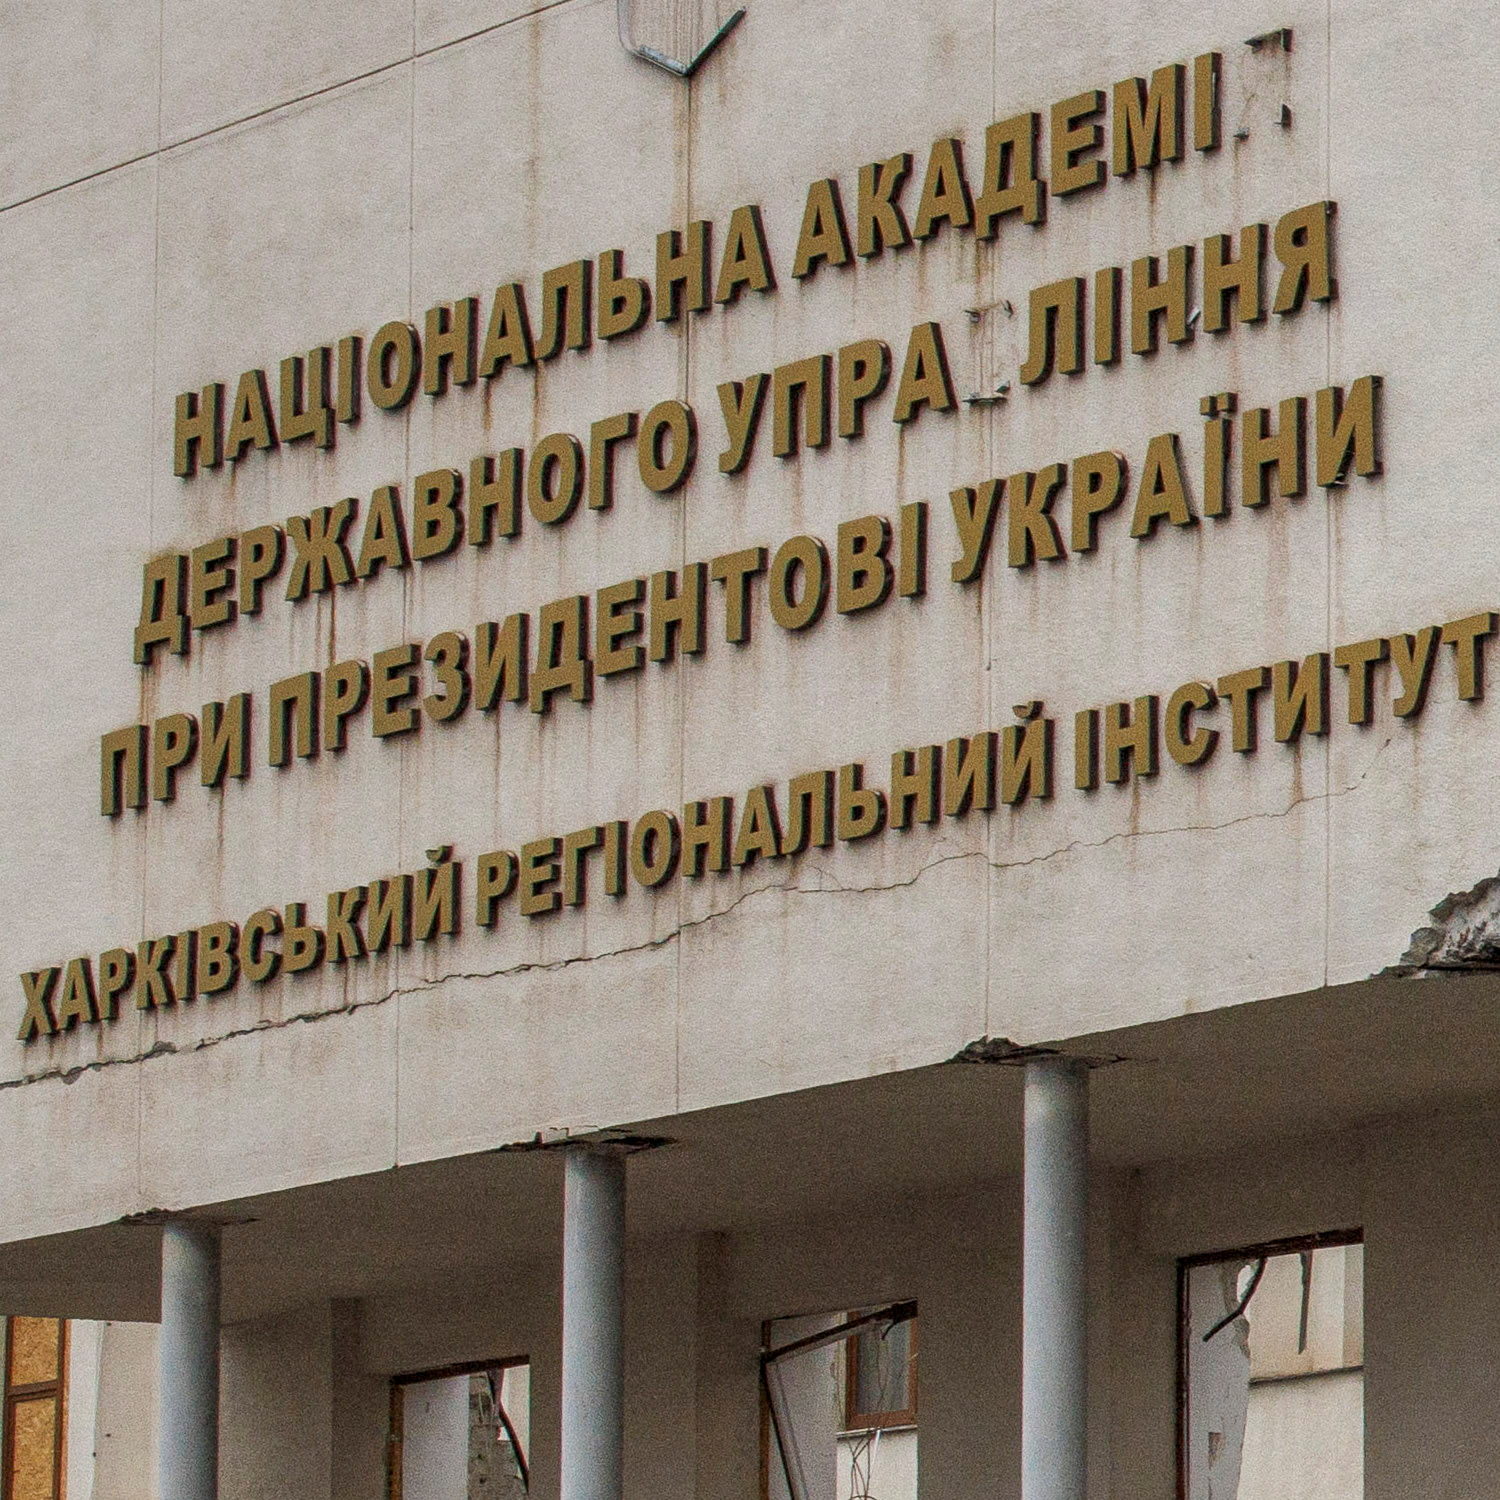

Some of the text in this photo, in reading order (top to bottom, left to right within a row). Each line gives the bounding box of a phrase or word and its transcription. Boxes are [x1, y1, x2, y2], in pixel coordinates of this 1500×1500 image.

[133, 200, 1338, 665] ДЕРЖАВНОГО УПРАЛІННЯ
[174, 28, 1294, 478] НАЦІОНАЛЬНА АКАДЕМІ
[100, 374, 1384, 817] ПРИ ПРЕЗИДЕНТОВІ УКРАЇНИ
[17, 611, 1500, 1042] ХАРКІВСЬКИЙ РЕГІОНАЛЬНИЙ ІНСТИТУТ
